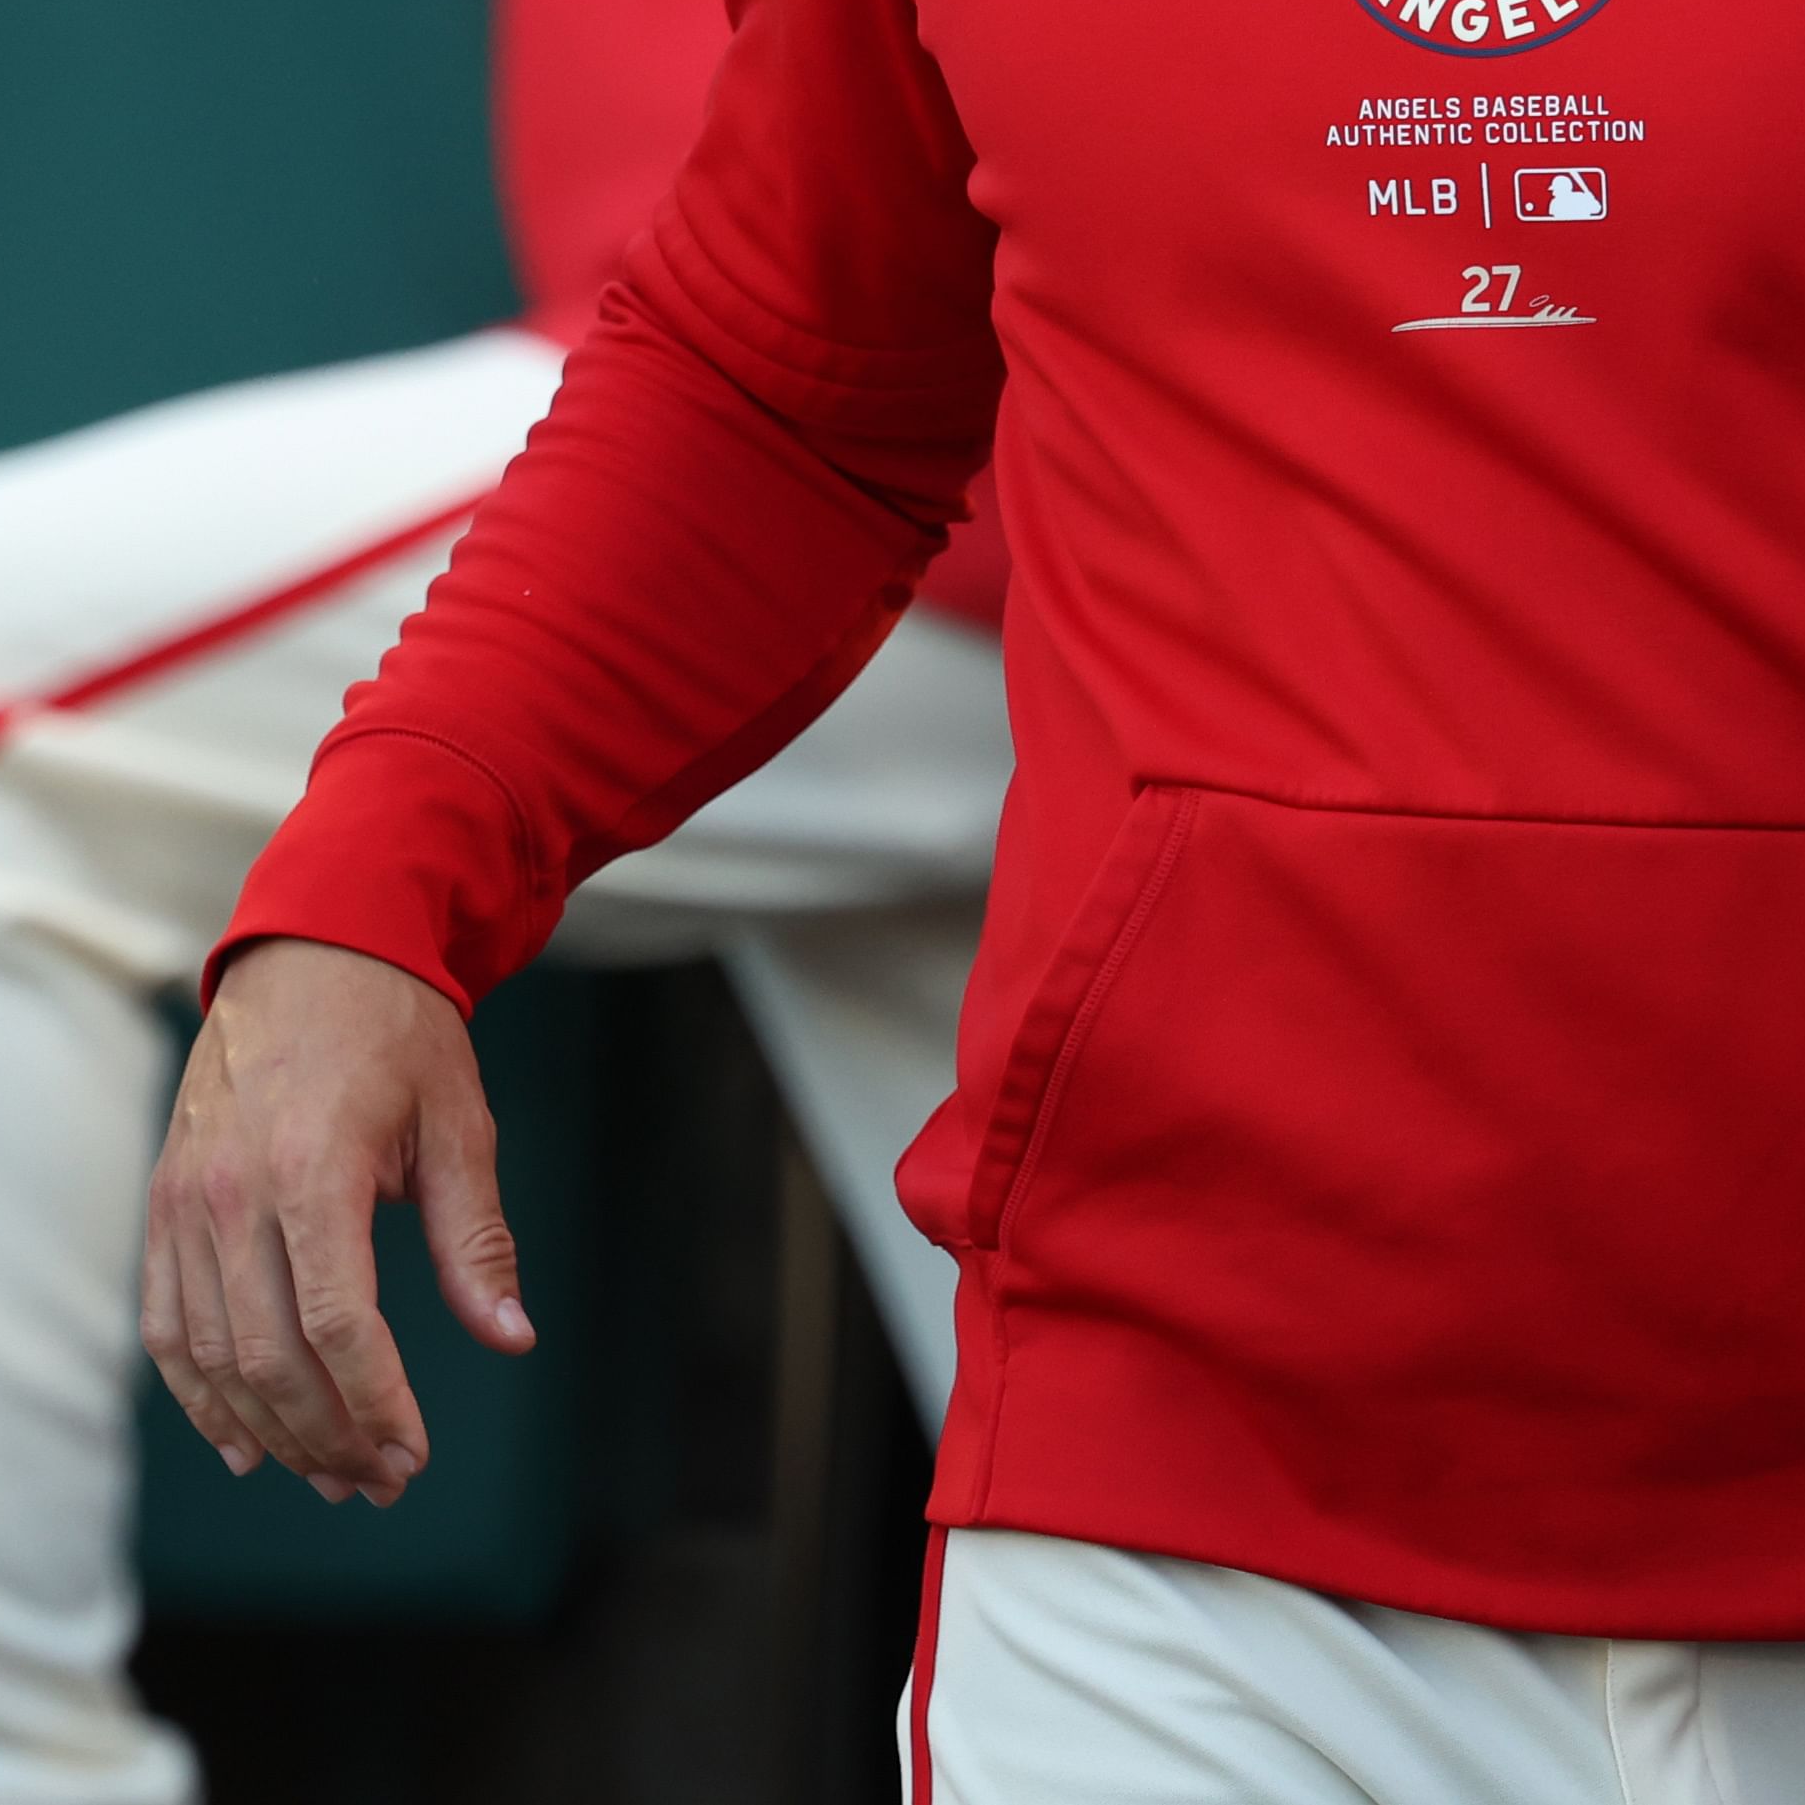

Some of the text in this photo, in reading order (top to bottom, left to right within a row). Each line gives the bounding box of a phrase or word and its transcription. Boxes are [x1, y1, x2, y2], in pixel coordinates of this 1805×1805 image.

[1357, 94, 1610, 121] ANGELS BASEBALL
[1325, 119, 1645, 147] AUTHENTIC COLLECTION
[1367, 178, 1458, 216] MLB
[1460, 264, 1523, 313] 27
